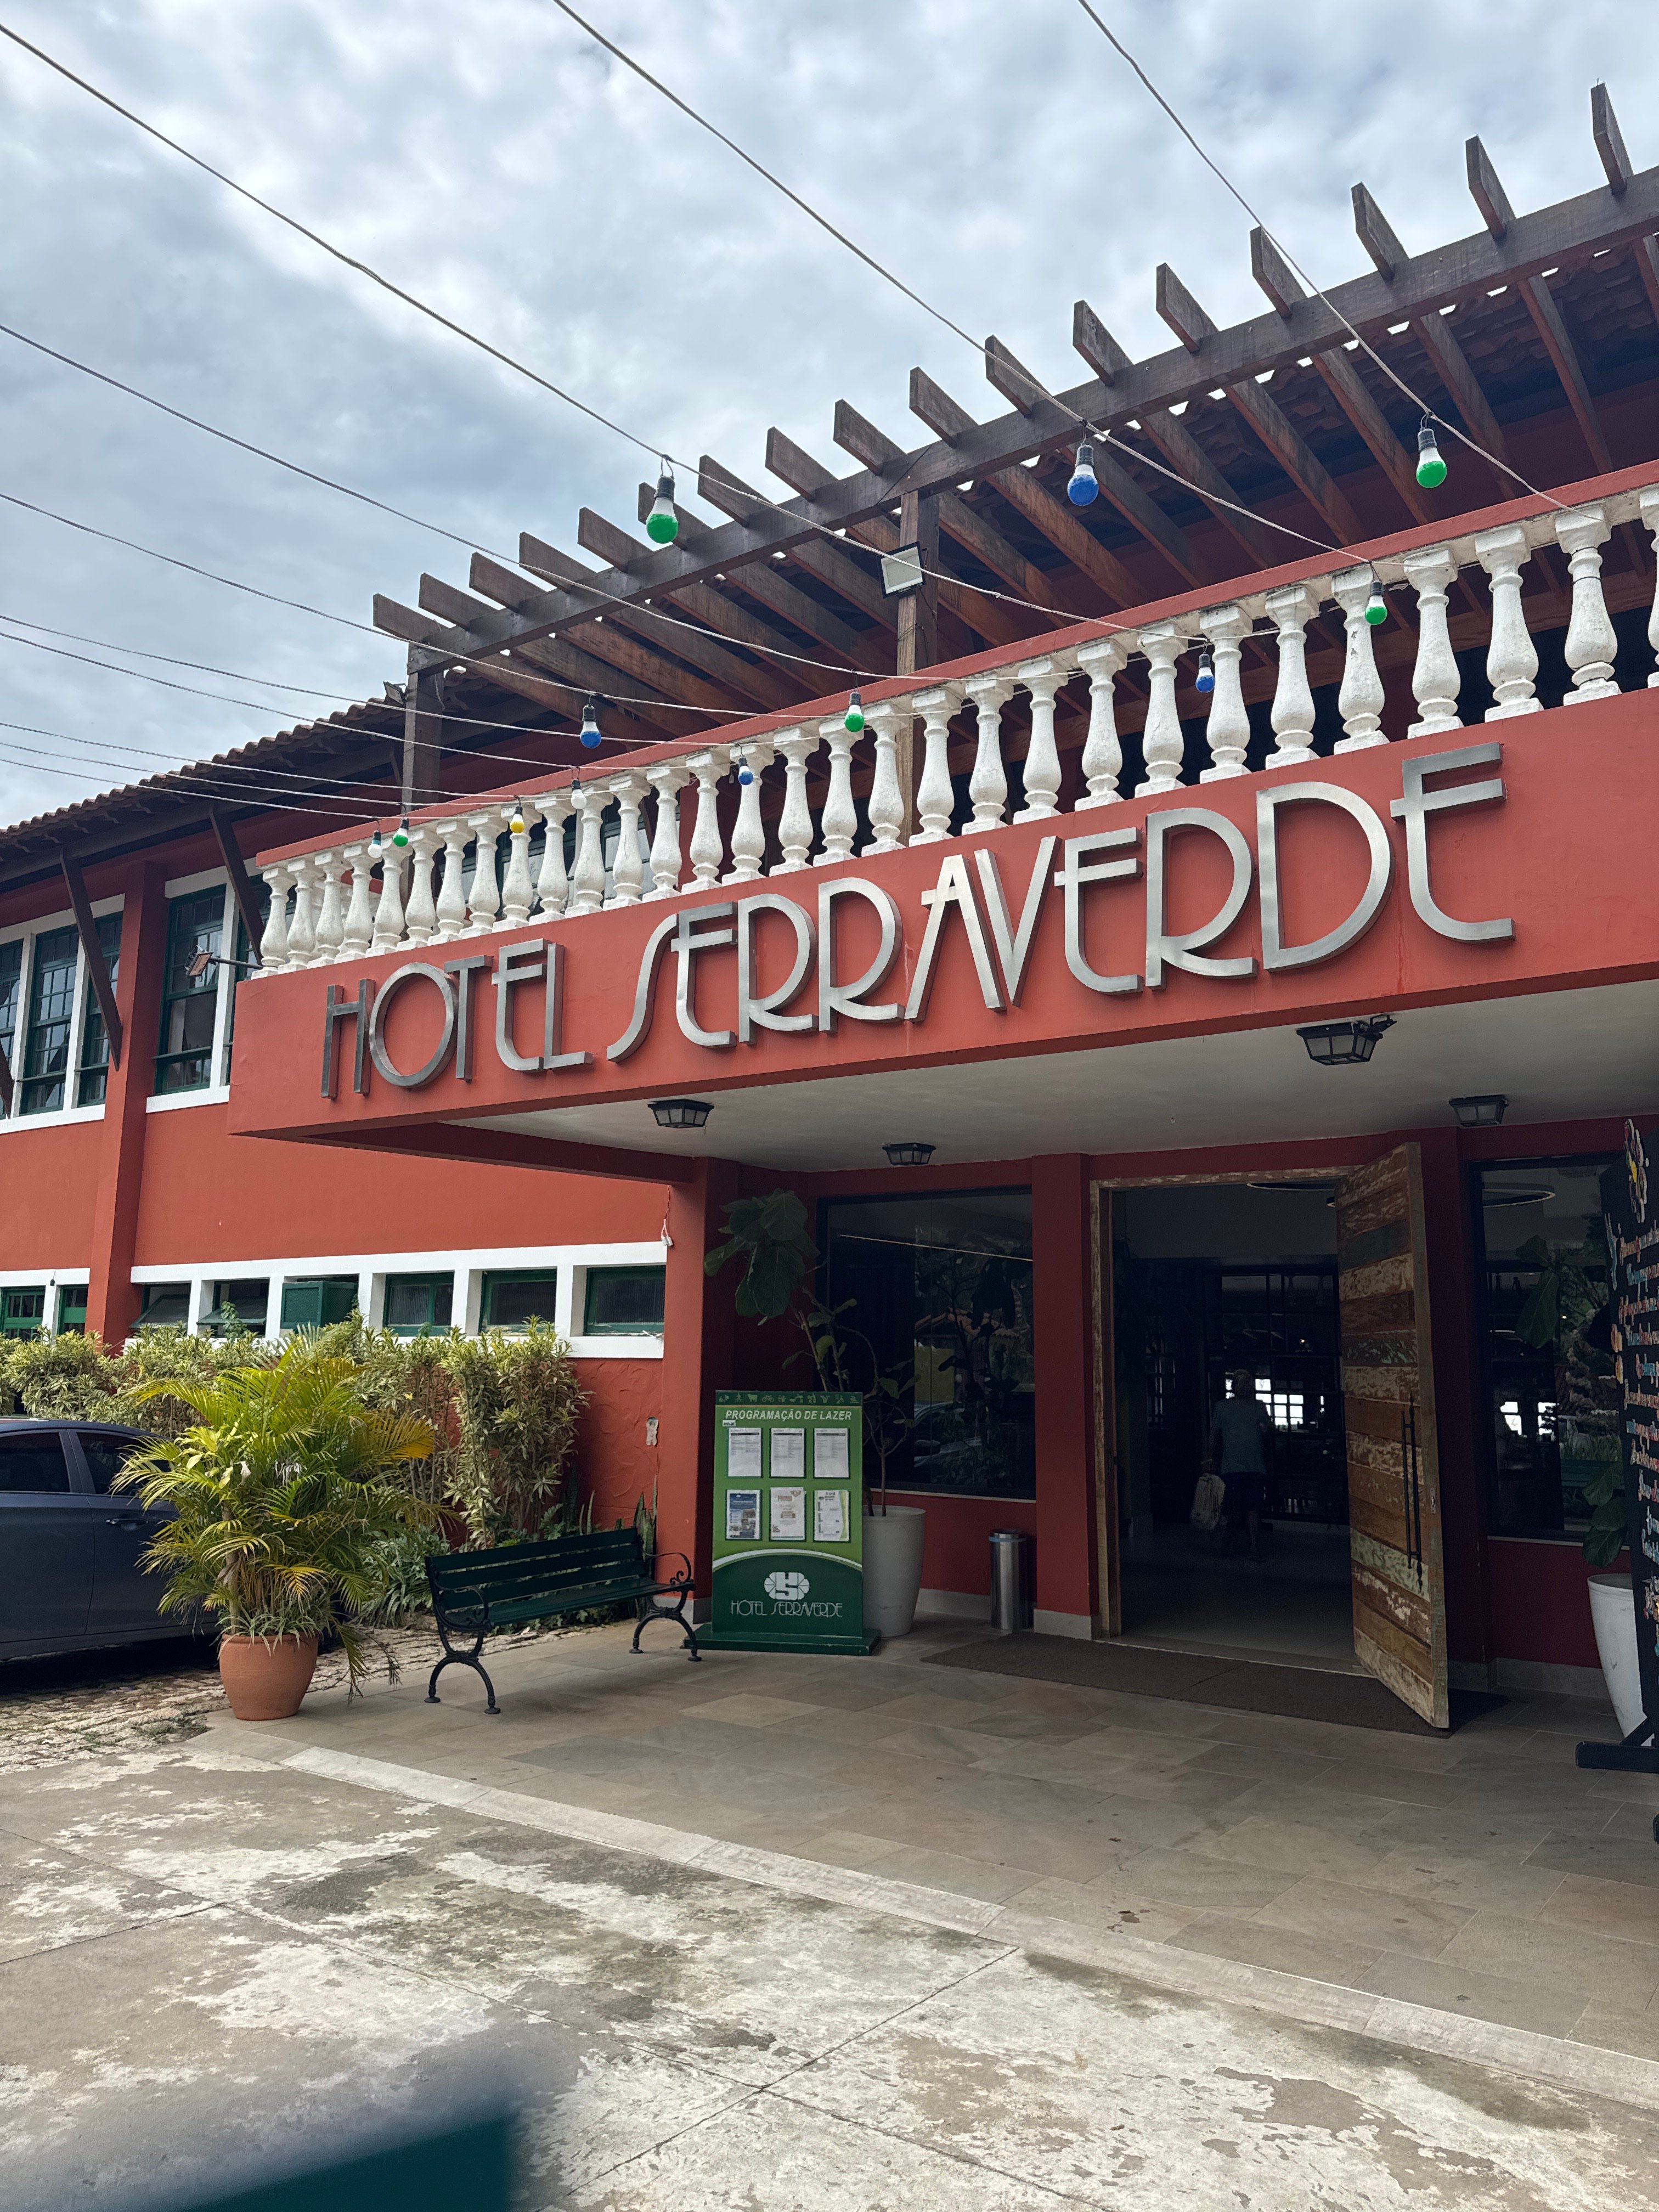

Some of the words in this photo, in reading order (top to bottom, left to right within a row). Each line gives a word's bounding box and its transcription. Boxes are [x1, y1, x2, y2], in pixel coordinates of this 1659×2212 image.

[321, 938, 592, 1099] HOTEL
[606, 742, 1515, 1063] SERRAVERDE
[725, 1408, 802, 1421] PROGRAMAÇÃO
[804, 1410, 817, 1420] DE
[820, 1410, 852, 1420] LAZER
[731, 1600, 768, 1616] HOTEL
[770, 1601, 843, 1617] SERRAVERDE
